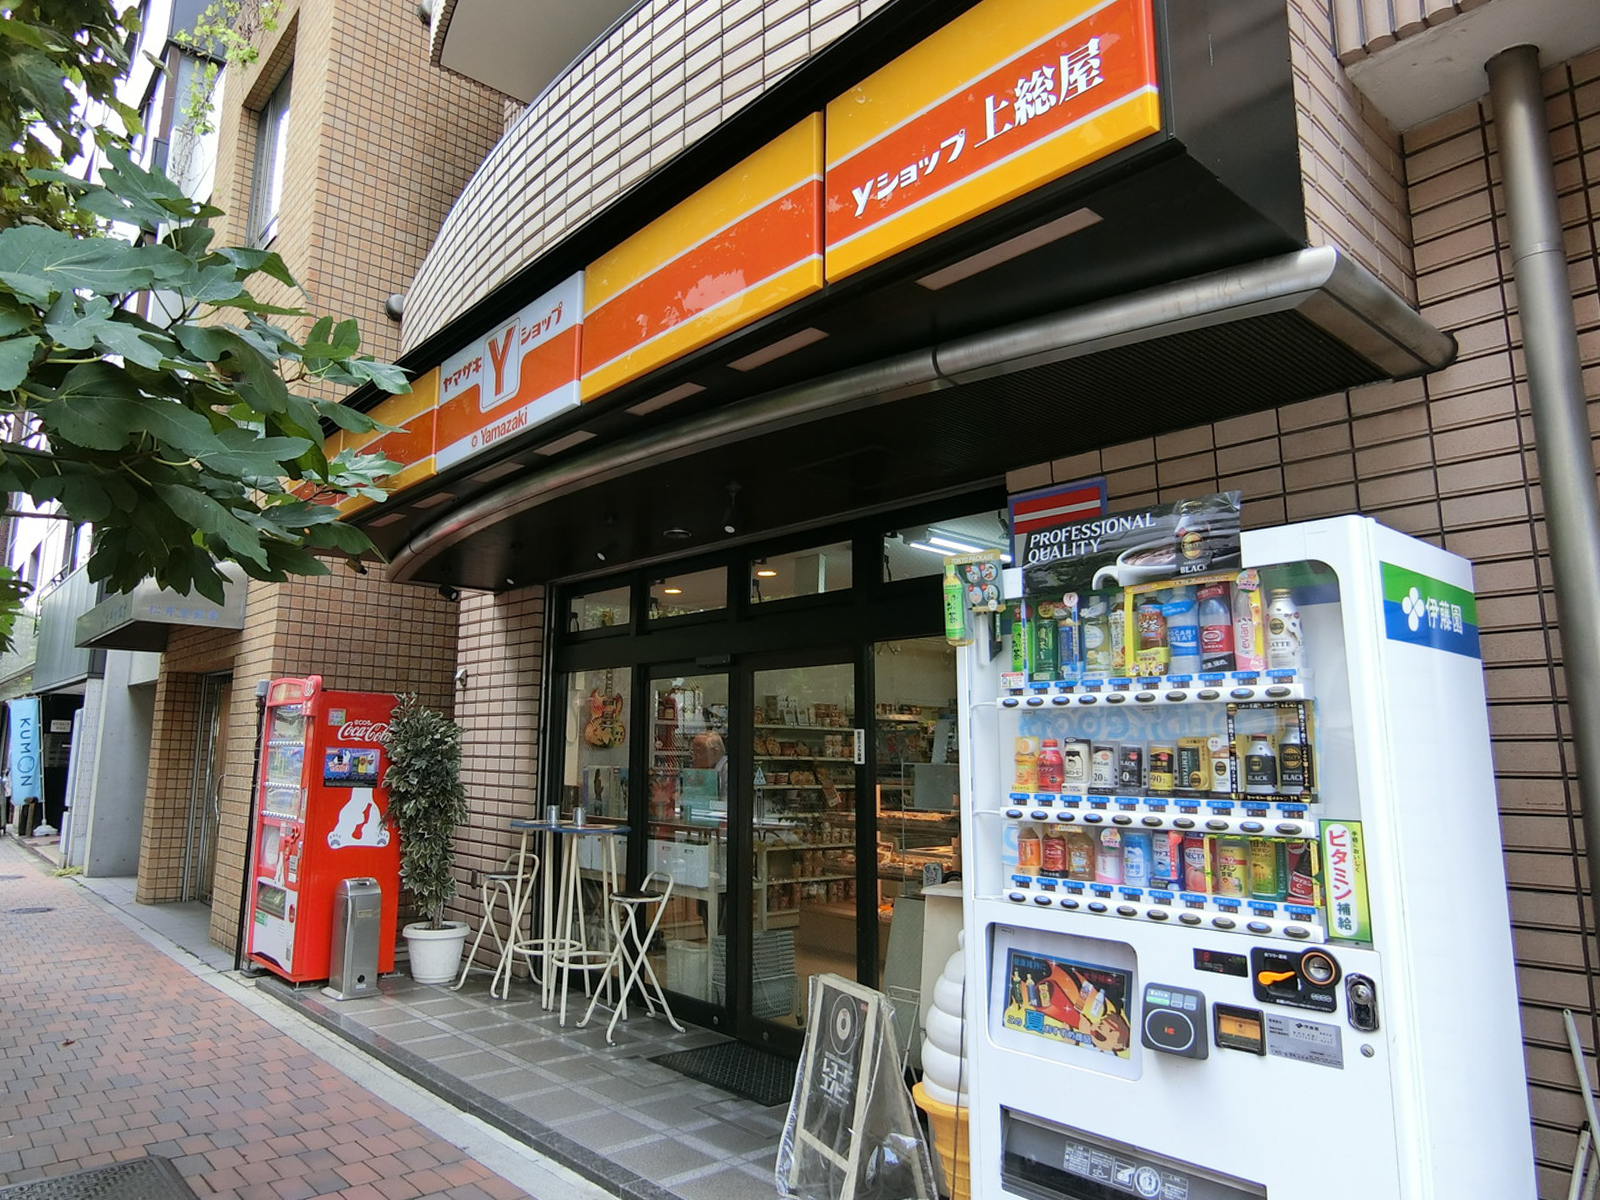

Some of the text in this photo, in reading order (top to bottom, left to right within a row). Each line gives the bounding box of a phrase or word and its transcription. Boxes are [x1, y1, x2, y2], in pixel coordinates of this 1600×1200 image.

[851, 37, 1104, 218] Yショップ 上総屋
[520, 301, 563, 346] ショップ
[443, 356, 482, 393] ヤマザキ
[480, 407, 528, 446] Yamazaki
[1029, 512, 1156, 548] PROFESSIONAL
[1028, 537, 1102, 565] QUALITY
[1425, 596, 1463, 635] 伊藤園
[17, 717, 35, 787] KUMON
[1328, 829, 1352, 931] ビタミン補給
